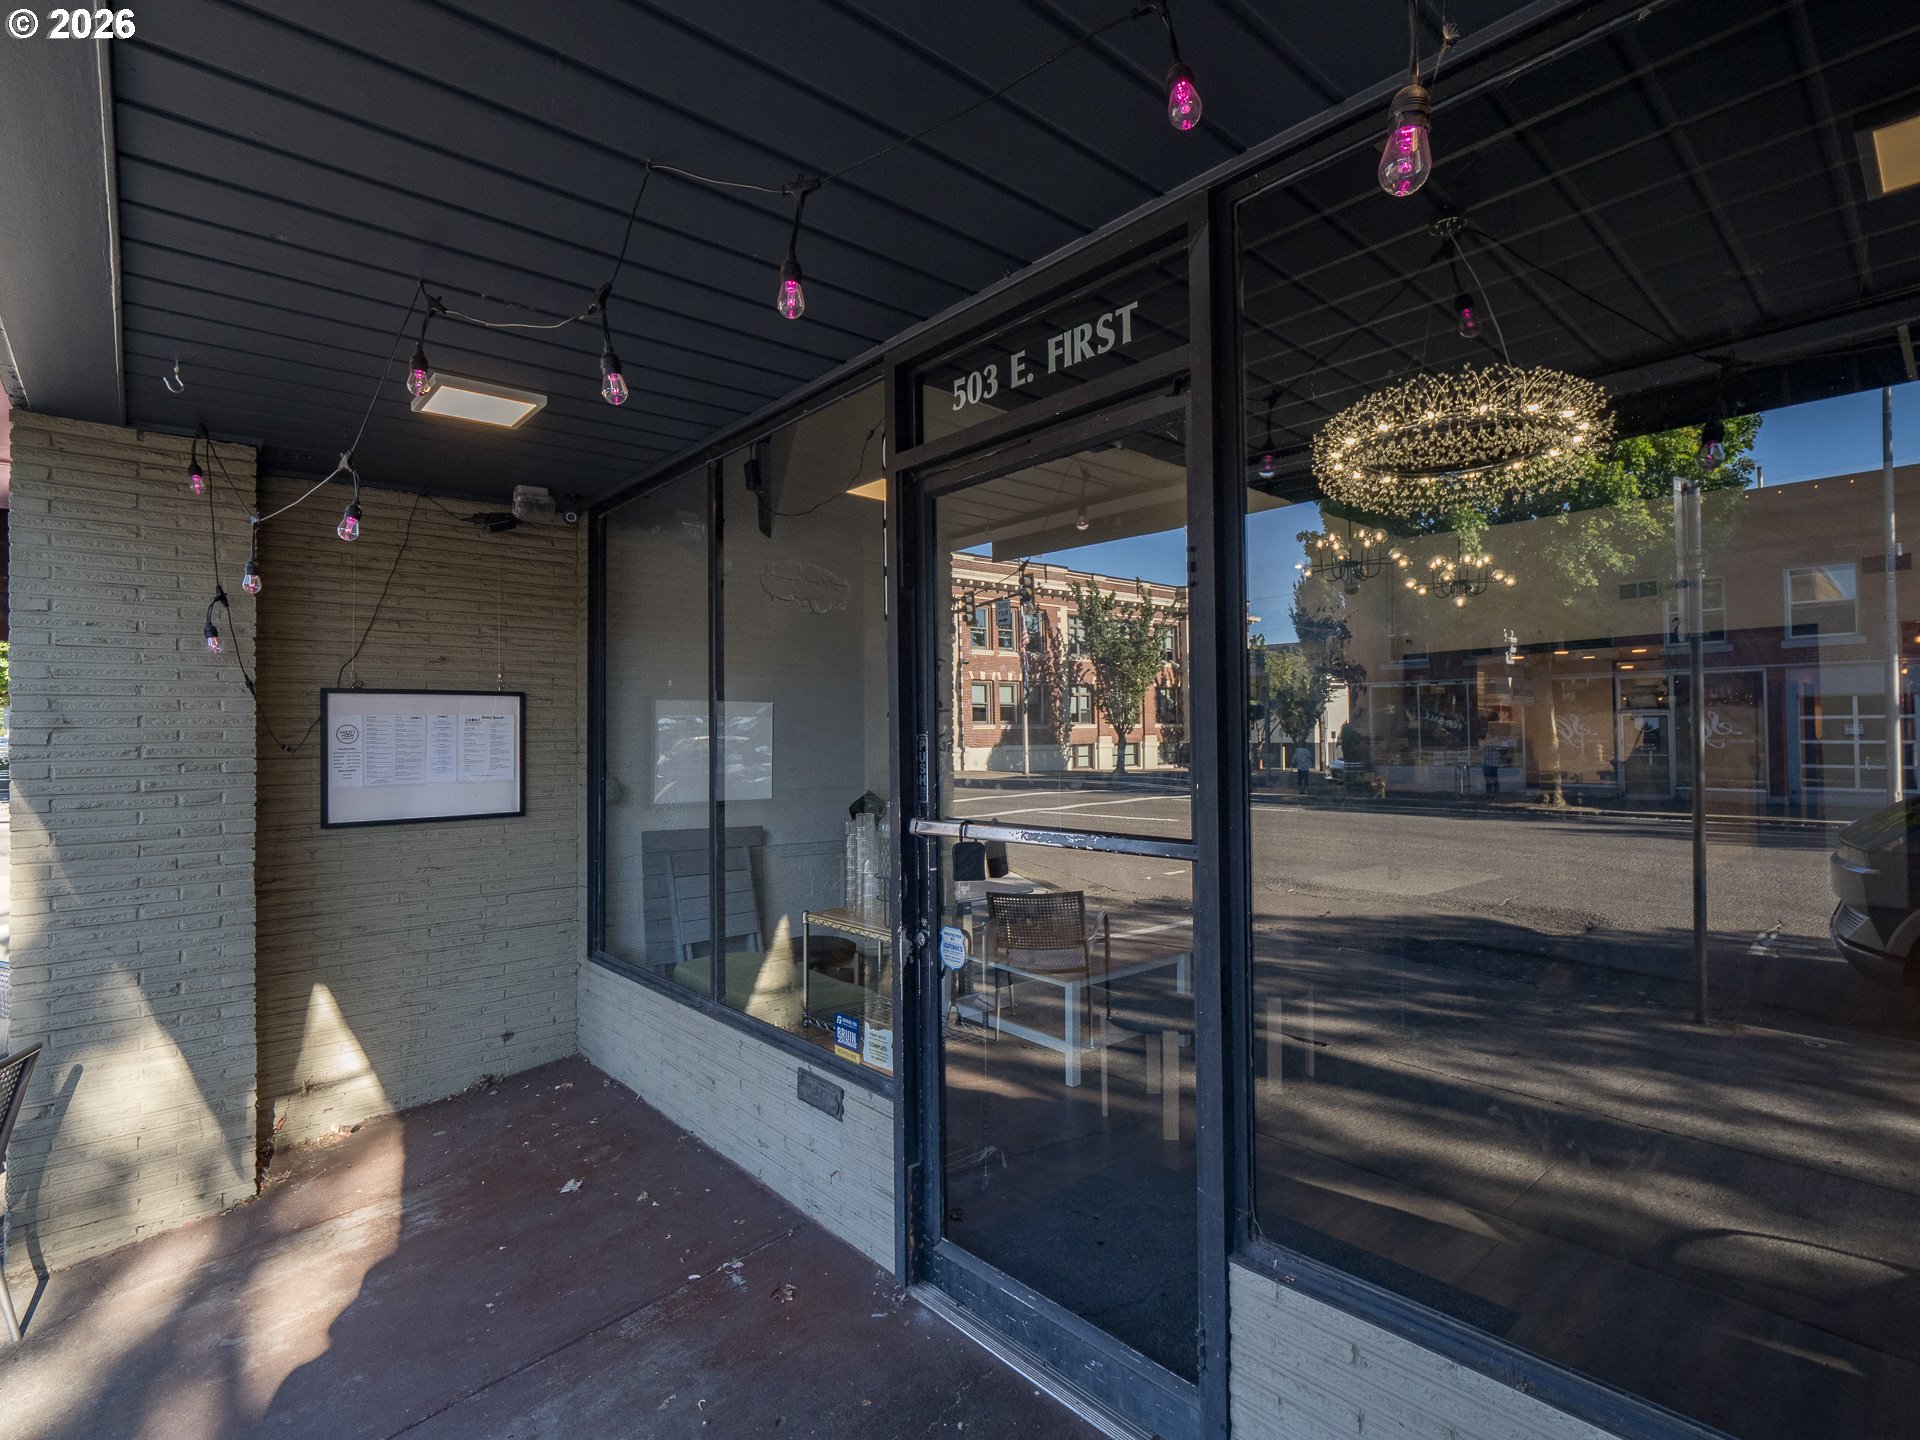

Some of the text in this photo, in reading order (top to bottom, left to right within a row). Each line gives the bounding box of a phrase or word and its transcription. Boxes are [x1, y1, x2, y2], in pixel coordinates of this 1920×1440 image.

[952, 300, 1138, 411] 503 E. FIRST
[837, 1027, 856, 1043] BRUIN
